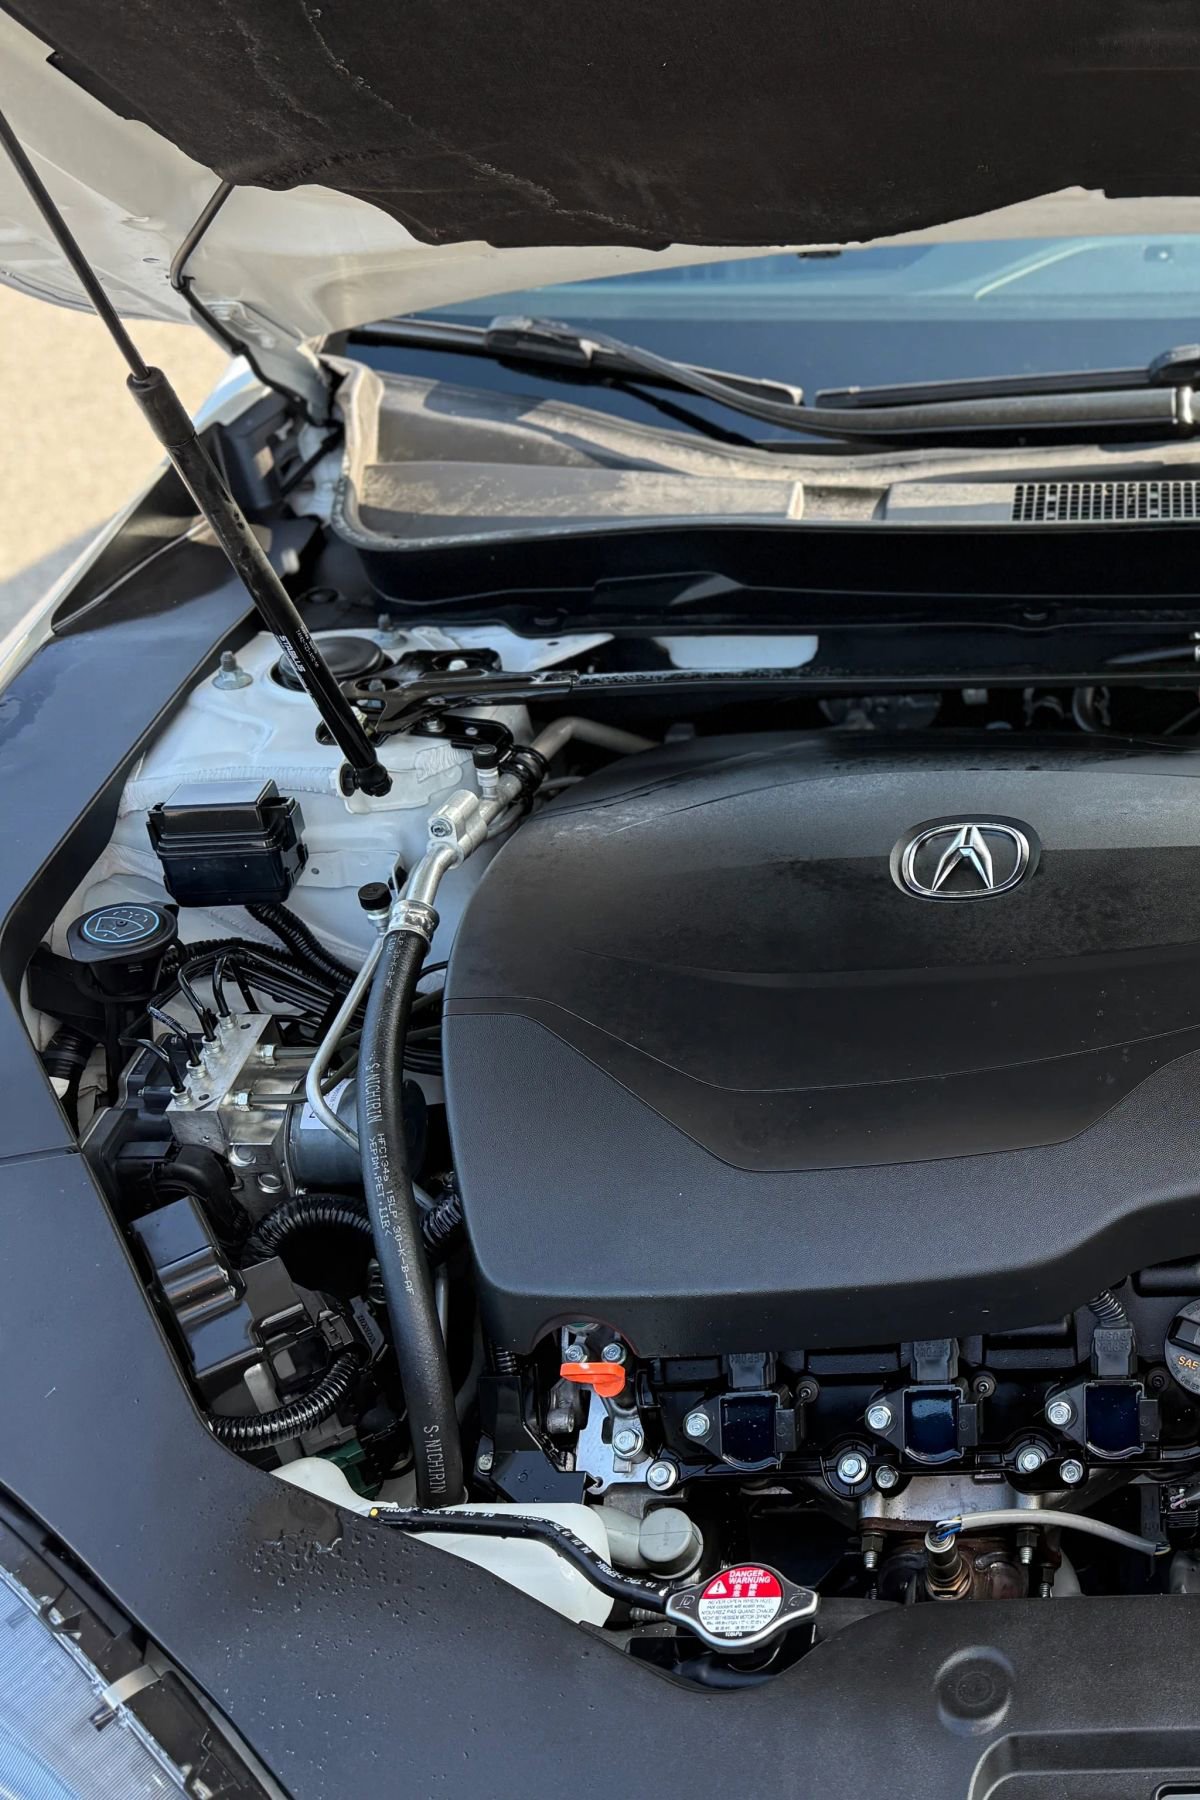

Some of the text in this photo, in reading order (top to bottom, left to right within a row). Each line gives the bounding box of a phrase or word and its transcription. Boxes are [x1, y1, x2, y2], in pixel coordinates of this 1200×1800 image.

[393, 1224, 415, 1296] 30-K-B-AF
[729, 1569, 764, 1578] DANGER
[728, 1576, 771, 1584] WARNUNG
